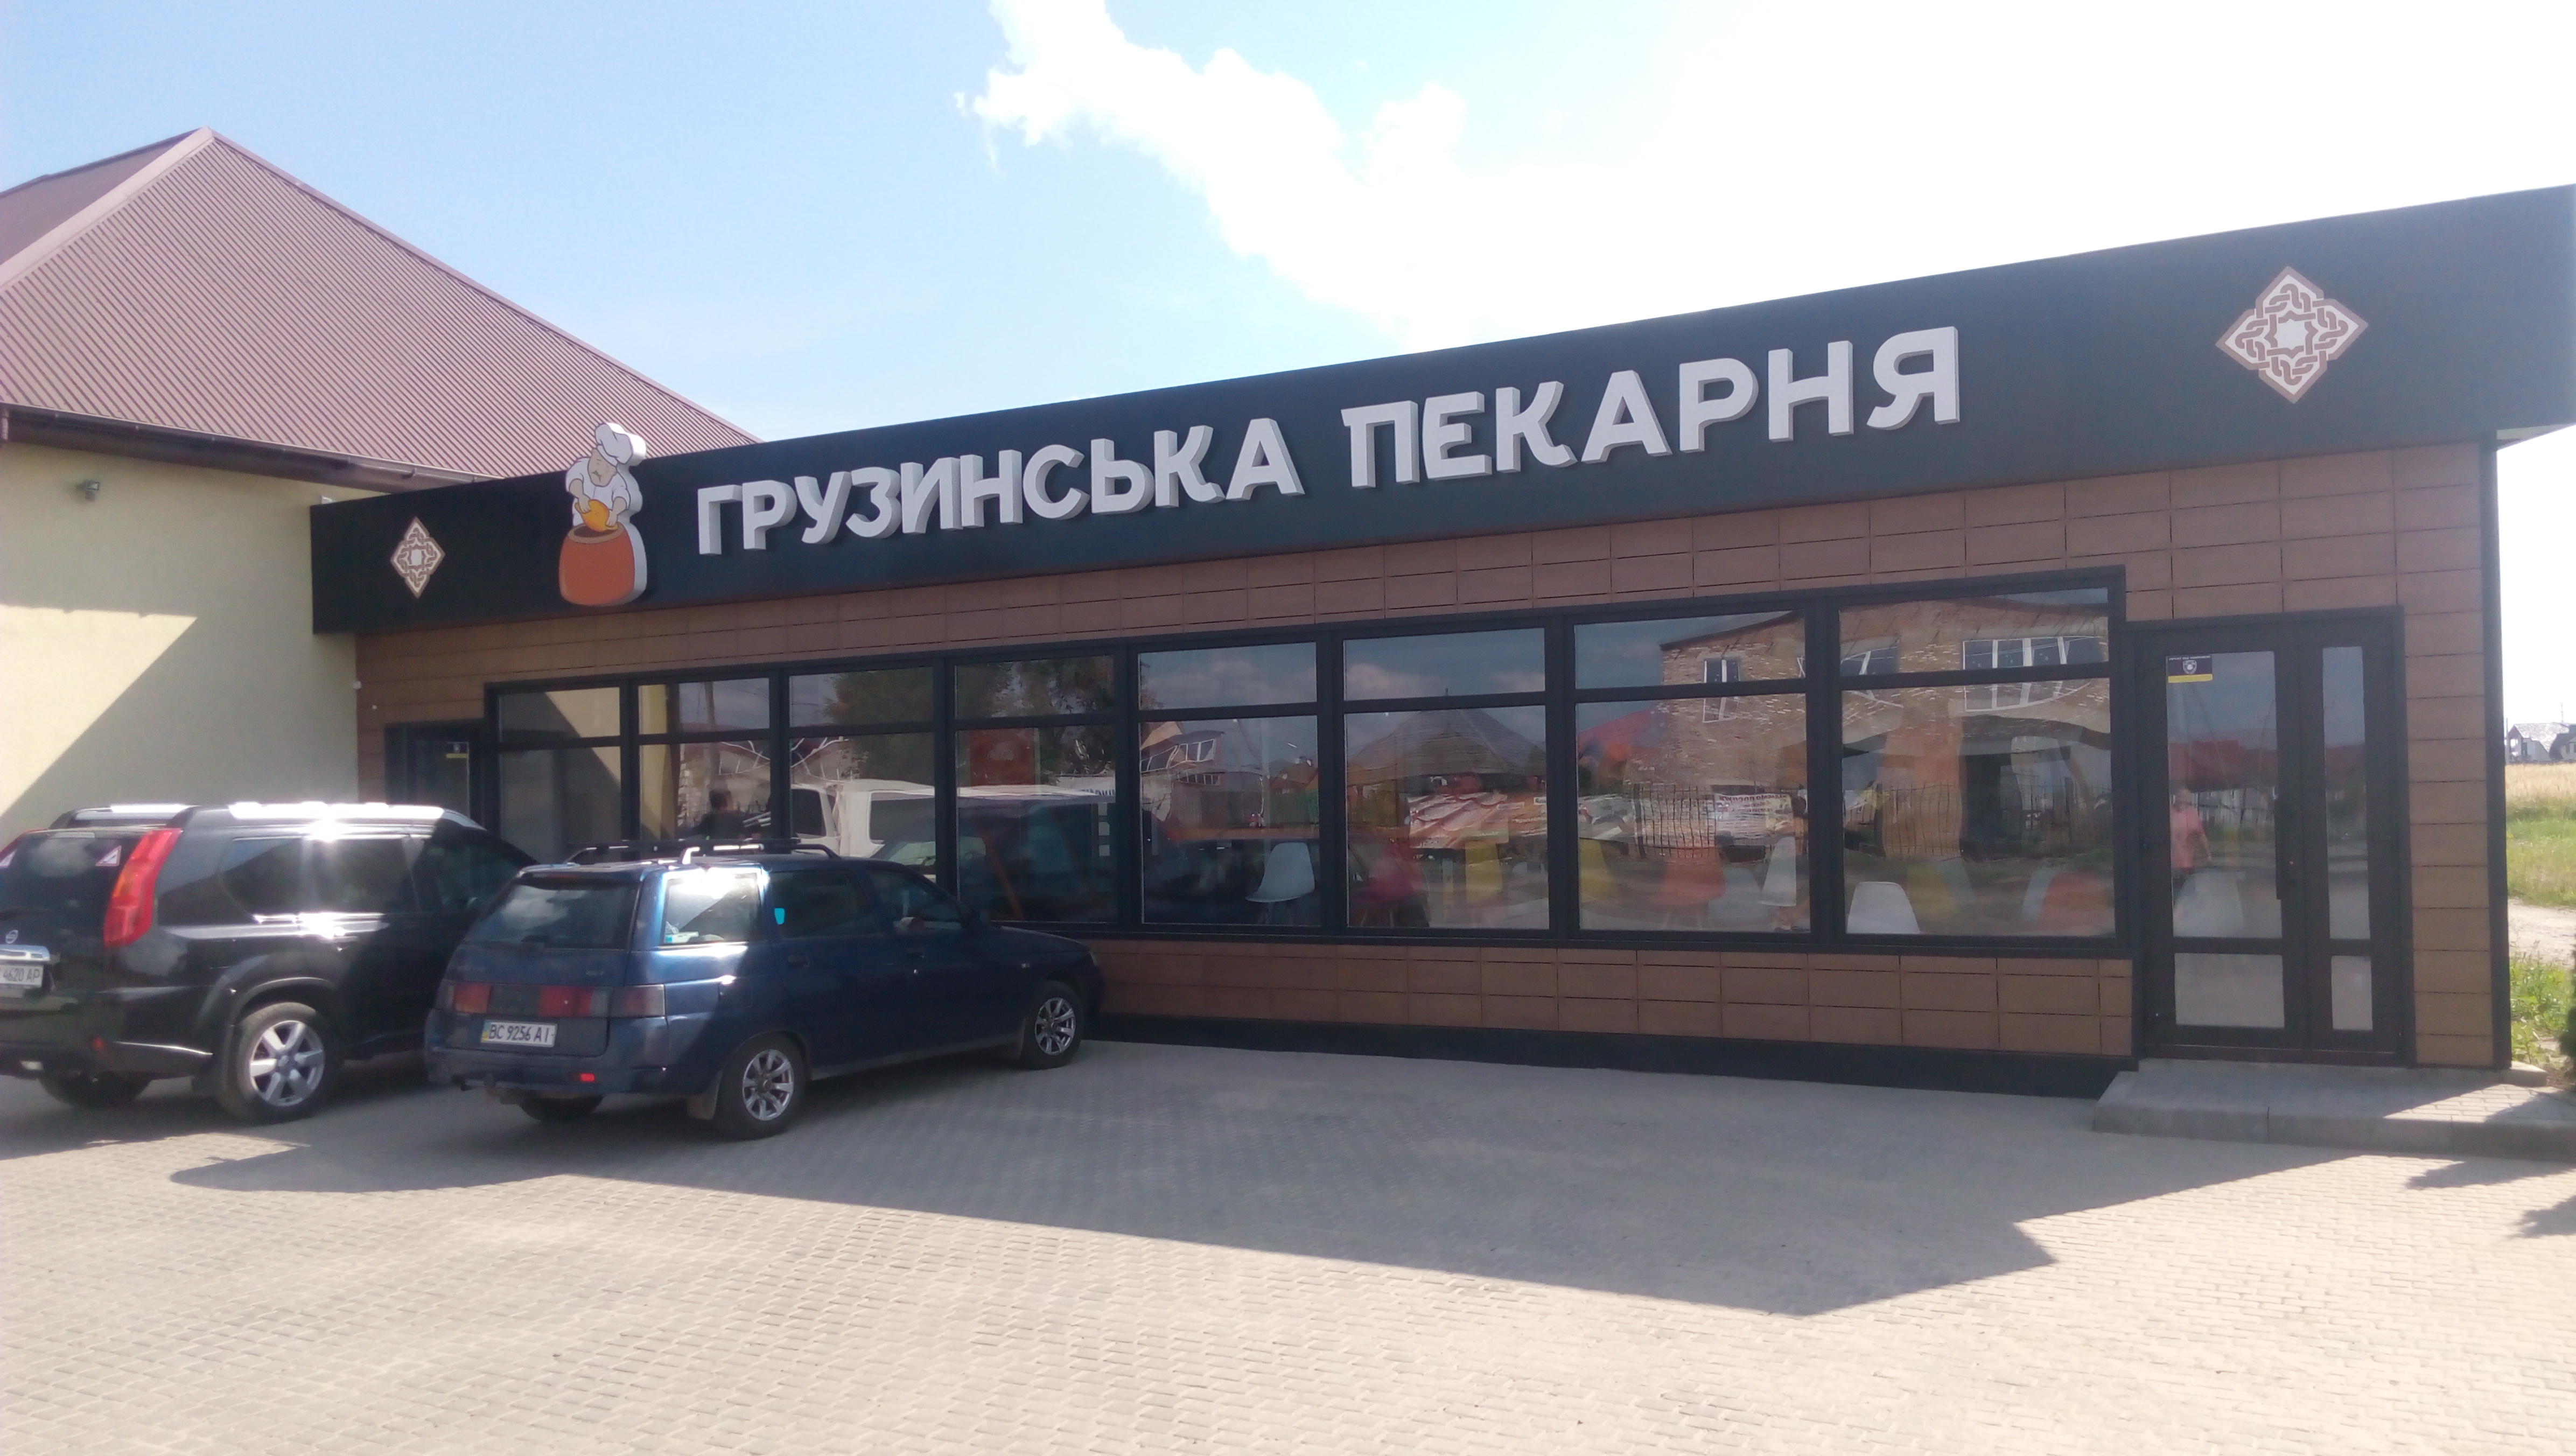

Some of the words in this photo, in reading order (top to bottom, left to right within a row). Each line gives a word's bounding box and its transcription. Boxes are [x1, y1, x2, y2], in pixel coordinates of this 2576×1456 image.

[697, 417, 1305, 555] ГРУЗИНСЬКА
[1340, 326, 1961, 489] ПЕКАРНЯ
[488, 1024, 505, 1040] BC
[506, 1025, 533, 1041] 9256
